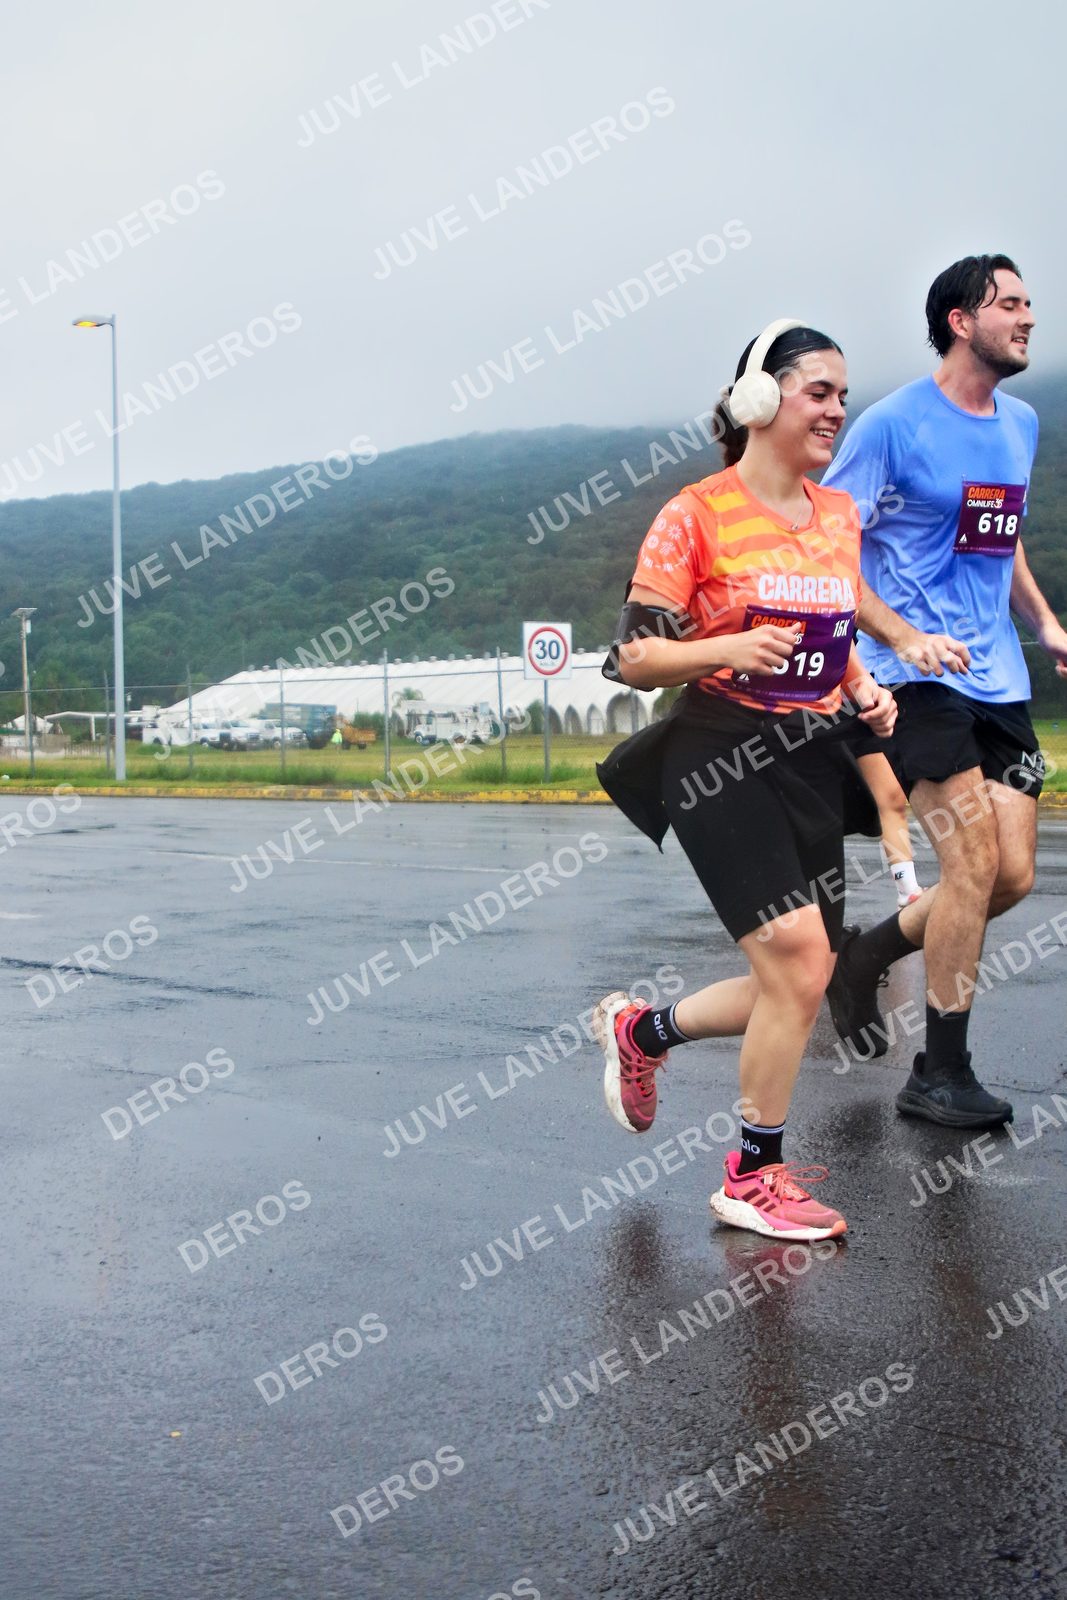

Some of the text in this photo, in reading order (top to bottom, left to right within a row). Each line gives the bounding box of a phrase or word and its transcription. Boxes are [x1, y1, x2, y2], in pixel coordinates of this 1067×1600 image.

[968, 487, 1006, 499] CARRERA
[978, 513, 1018, 535] 618
[758, 574, 856, 604] CARRERA
[535, 639, 560, 659] 30
[654, 1013, 668, 1040] alo
[741, 1138, 760, 1154] alo
